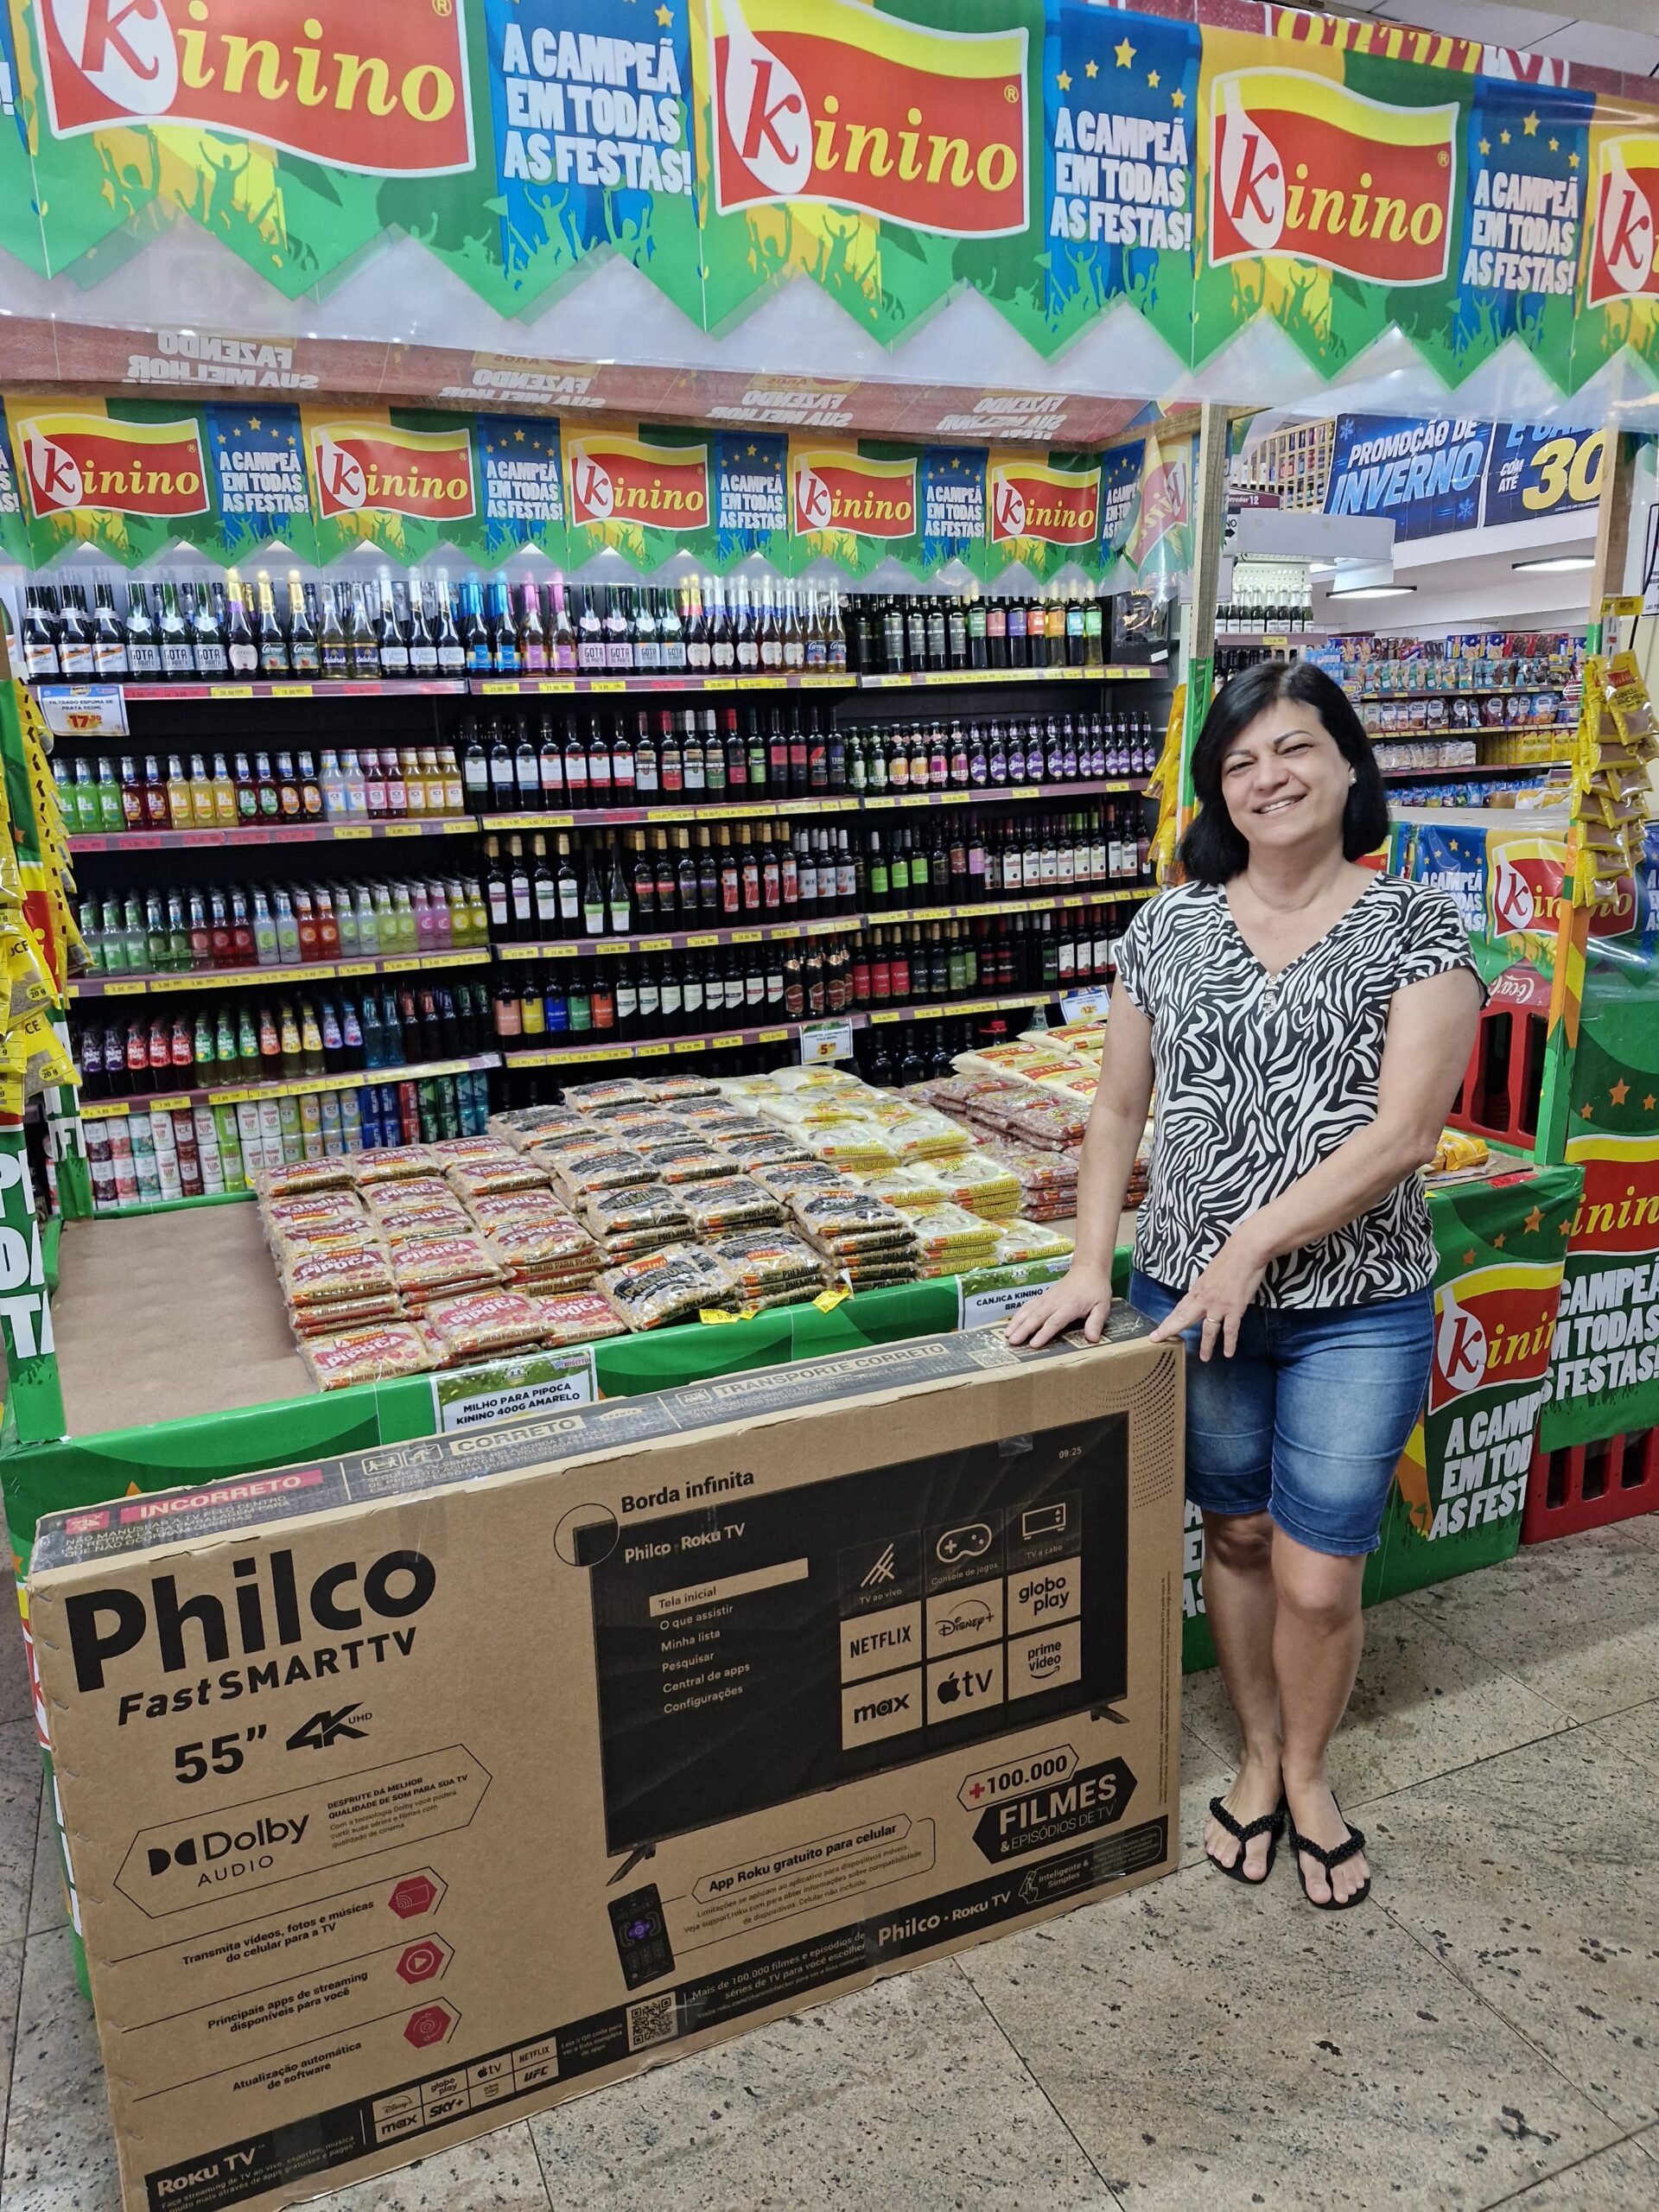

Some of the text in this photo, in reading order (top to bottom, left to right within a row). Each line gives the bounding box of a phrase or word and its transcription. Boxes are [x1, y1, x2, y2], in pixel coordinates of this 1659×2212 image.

[503, 22, 683, 95] A CAMPEÃ
[506, 77, 682, 144] EM TODAS
[1054, 106, 1188, 165] A CAMPEÃ
[504, 130, 692, 196] AS FESTAS!
[1056, 151, 1186, 208] EM TODAS
[1473, 168, 1579, 219] A CAMPEÃ
[1050, 195, 1192, 251] AS FESTAS!
[1471, 208, 1507, 249] EM
[1508, 213, 1575, 257] TODAS
[1462, 248, 1576, 296] AS FESTAS!
[1348, 418, 1446, 468] PROMOÇÃO
[1451, 420, 1478, 442] DE
[219, 449, 302, 473] A CAMPEÃ
[1499, 459, 1524, 476] COM
[223, 472, 302, 493] EM TODAS
[1329, 441, 1484, 516] INVERNO
[1497, 474, 1519, 493] ATÉ
[222, 493, 308, 513] AS FESTAS!
[1249, 495, 1260, 505] 12
[584, 647, 603, 658] GOTA
[29, 989, 40, 999] 20
[301, 1254, 378, 1277] PIPOCA
[976, 1288, 1044, 1306] CANJICA KININO
[327, 1336, 405, 1367] PIPOCA
[715, 1361, 850, 1394] TRANSPORTE
[854, 1345, 945, 1368] CORRETO
[456, 1393, 581, 1426] KININO 400G AMARELO
[463, 1382, 572, 1413] MILHO PARA PIPOCA
[457, 1419, 576, 1452] CORRETO
[1444, 1391, 1539, 1459] A CAMP
[1058, 1446, 1082, 1459] 09:25
[1441, 1450, 1487, 1500] EM
[140, 1476, 302, 1518] INCORRETO
[621, 1471, 754, 1514] Borda infinita
[1427, 1497, 1468, 1541] AS
[625, 1540, 671, 1564] Philco
[724, 1522, 746, 1540] TV
[1026, 1550, 1038, 1560] TV
[1044, 1543, 1063, 1555] cabo
[931, 1562, 998, 1586] Console de jogos
[1019, 1576, 1066, 1604] globo
[658, 1586, 716, 1610] Tela inicial
[859, 1588, 902, 1605] TV ao vivo
[1033, 1591, 1070, 1616] play
[65, 1549, 436, 1694] Philco
[659, 1604, 734, 1630] O que assistir
[661, 1629, 721, 1652] Minha lista
[850, 1625, 912, 1658] NETFLIX
[1027, 1641, 1062, 1661] prime
[662, 1651, 715, 1673] Pesquisar
[1028, 1655, 1061, 1672] video
[663, 1663, 750, 1694] Central de apps
[964, 1669, 993, 1698] tv
[118, 1678, 212, 1726] Fast
[664, 1685, 743, 1713] Configurações
[854, 1694, 910, 1724] max
[285, 1701, 373, 1751] 4K UHD
[327, 1777, 423, 1809] DESFRUTE DA MELHOR
[328, 1800, 378, 1819] QUALIDADE
[391, 1790, 412, 1801] SOM
[413, 1783, 436, 1796] PARA
[438, 1778, 455, 1789] SUA
[457, 1774, 468, 1783] TV
[1000, 1773, 1117, 1835] FILMES
[203, 1814, 309, 1861] Dolby
[1001, 1803, 1115, 1853] & EPISÓDIOS DE TV
[198, 1855, 274, 1887] AUDIO
[709, 1823, 897, 1892] App Roku gratuito para celular
[182, 1941, 241, 1965] Transmita
[244, 1929, 284, 1947] vídeos,
[287, 1918, 317, 1933] fotos
[328, 1900, 374, 1921] músicas
[226, 1951, 241, 1963] do
[244, 1941, 282, 1958] celular
[284, 1931, 309, 1947] para
[321, 1923, 337, 1934] TV
[207, 1972, 368, 2030] Principais apps de streaming
[230, 1986, 350, 2032] disponíveis para você
[232, 2042, 362, 2091] Atualização automática
[518, 2045, 550, 2063] NETFLIX
[267, 2062, 332, 2090] de software
[524, 2065, 549, 2082] UFC
[429, 2098, 464, 2118] SKY+
